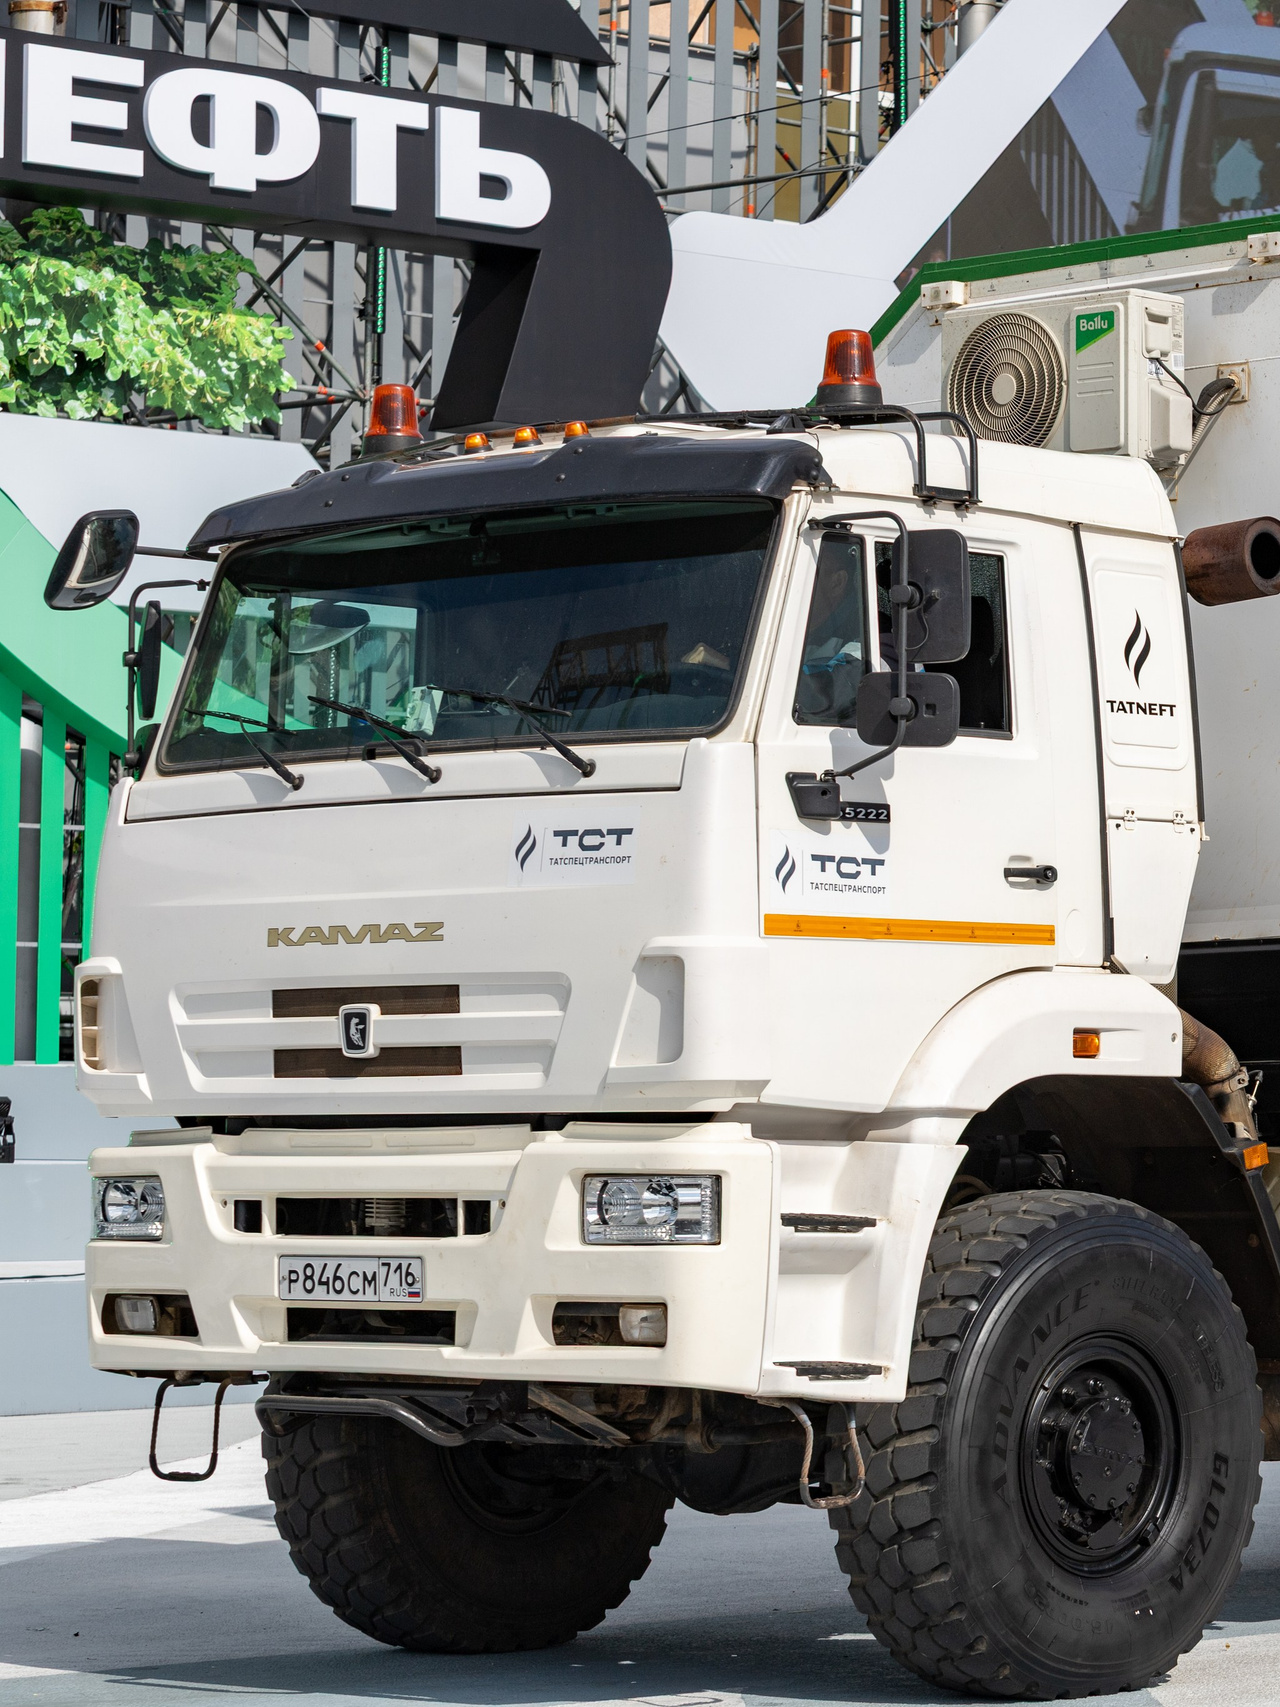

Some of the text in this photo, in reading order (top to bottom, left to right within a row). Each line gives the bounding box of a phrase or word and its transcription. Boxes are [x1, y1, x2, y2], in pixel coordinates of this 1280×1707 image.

[0, 38, 551, 230] ЕФТЬ
[1080, 314, 1108, 331] Ballu
[1106, 699, 1176, 717] TATNEFT
[840, 807, 888, 820] 5222
[549, 855, 632, 867] ТАТСПЕЦТРАНСПОРТ
[809, 881, 886, 895] ТАТСПЕЦТРАНСПОРТ
[267, 921, 445, 948] KAMAZ
[381, 1262, 416, 1287] 716
[389, 1287, 408, 1298] RUS
